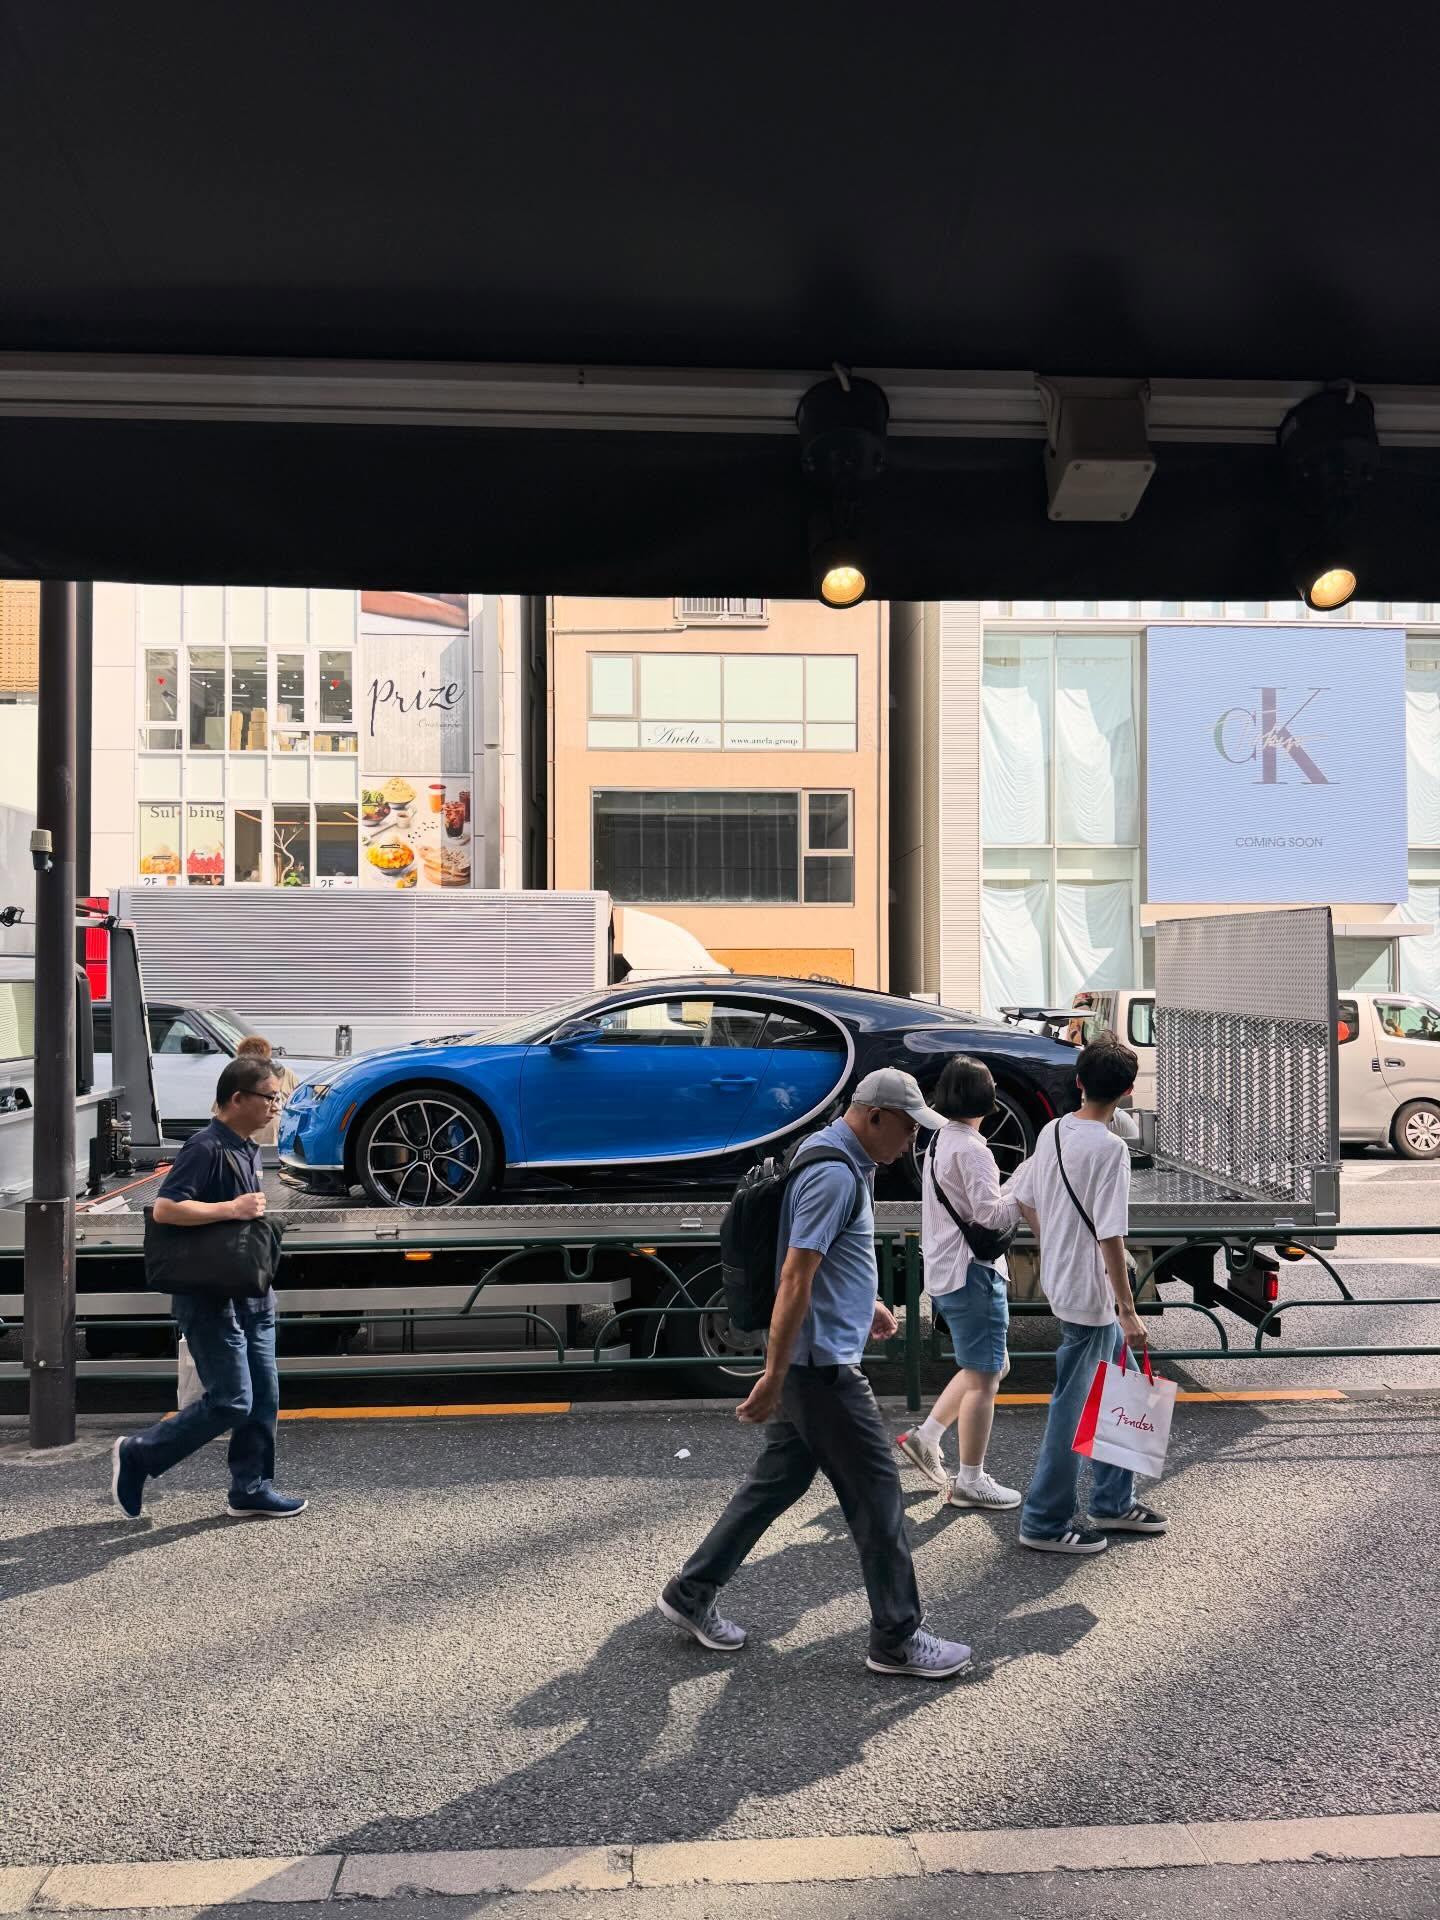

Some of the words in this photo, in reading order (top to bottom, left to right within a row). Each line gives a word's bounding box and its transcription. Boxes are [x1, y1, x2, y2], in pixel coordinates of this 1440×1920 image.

[1235, 837, 1286, 848] COMING
[1287, 837, 1323, 848] SOON
[1111, 1406, 1155, 1432] Fender
